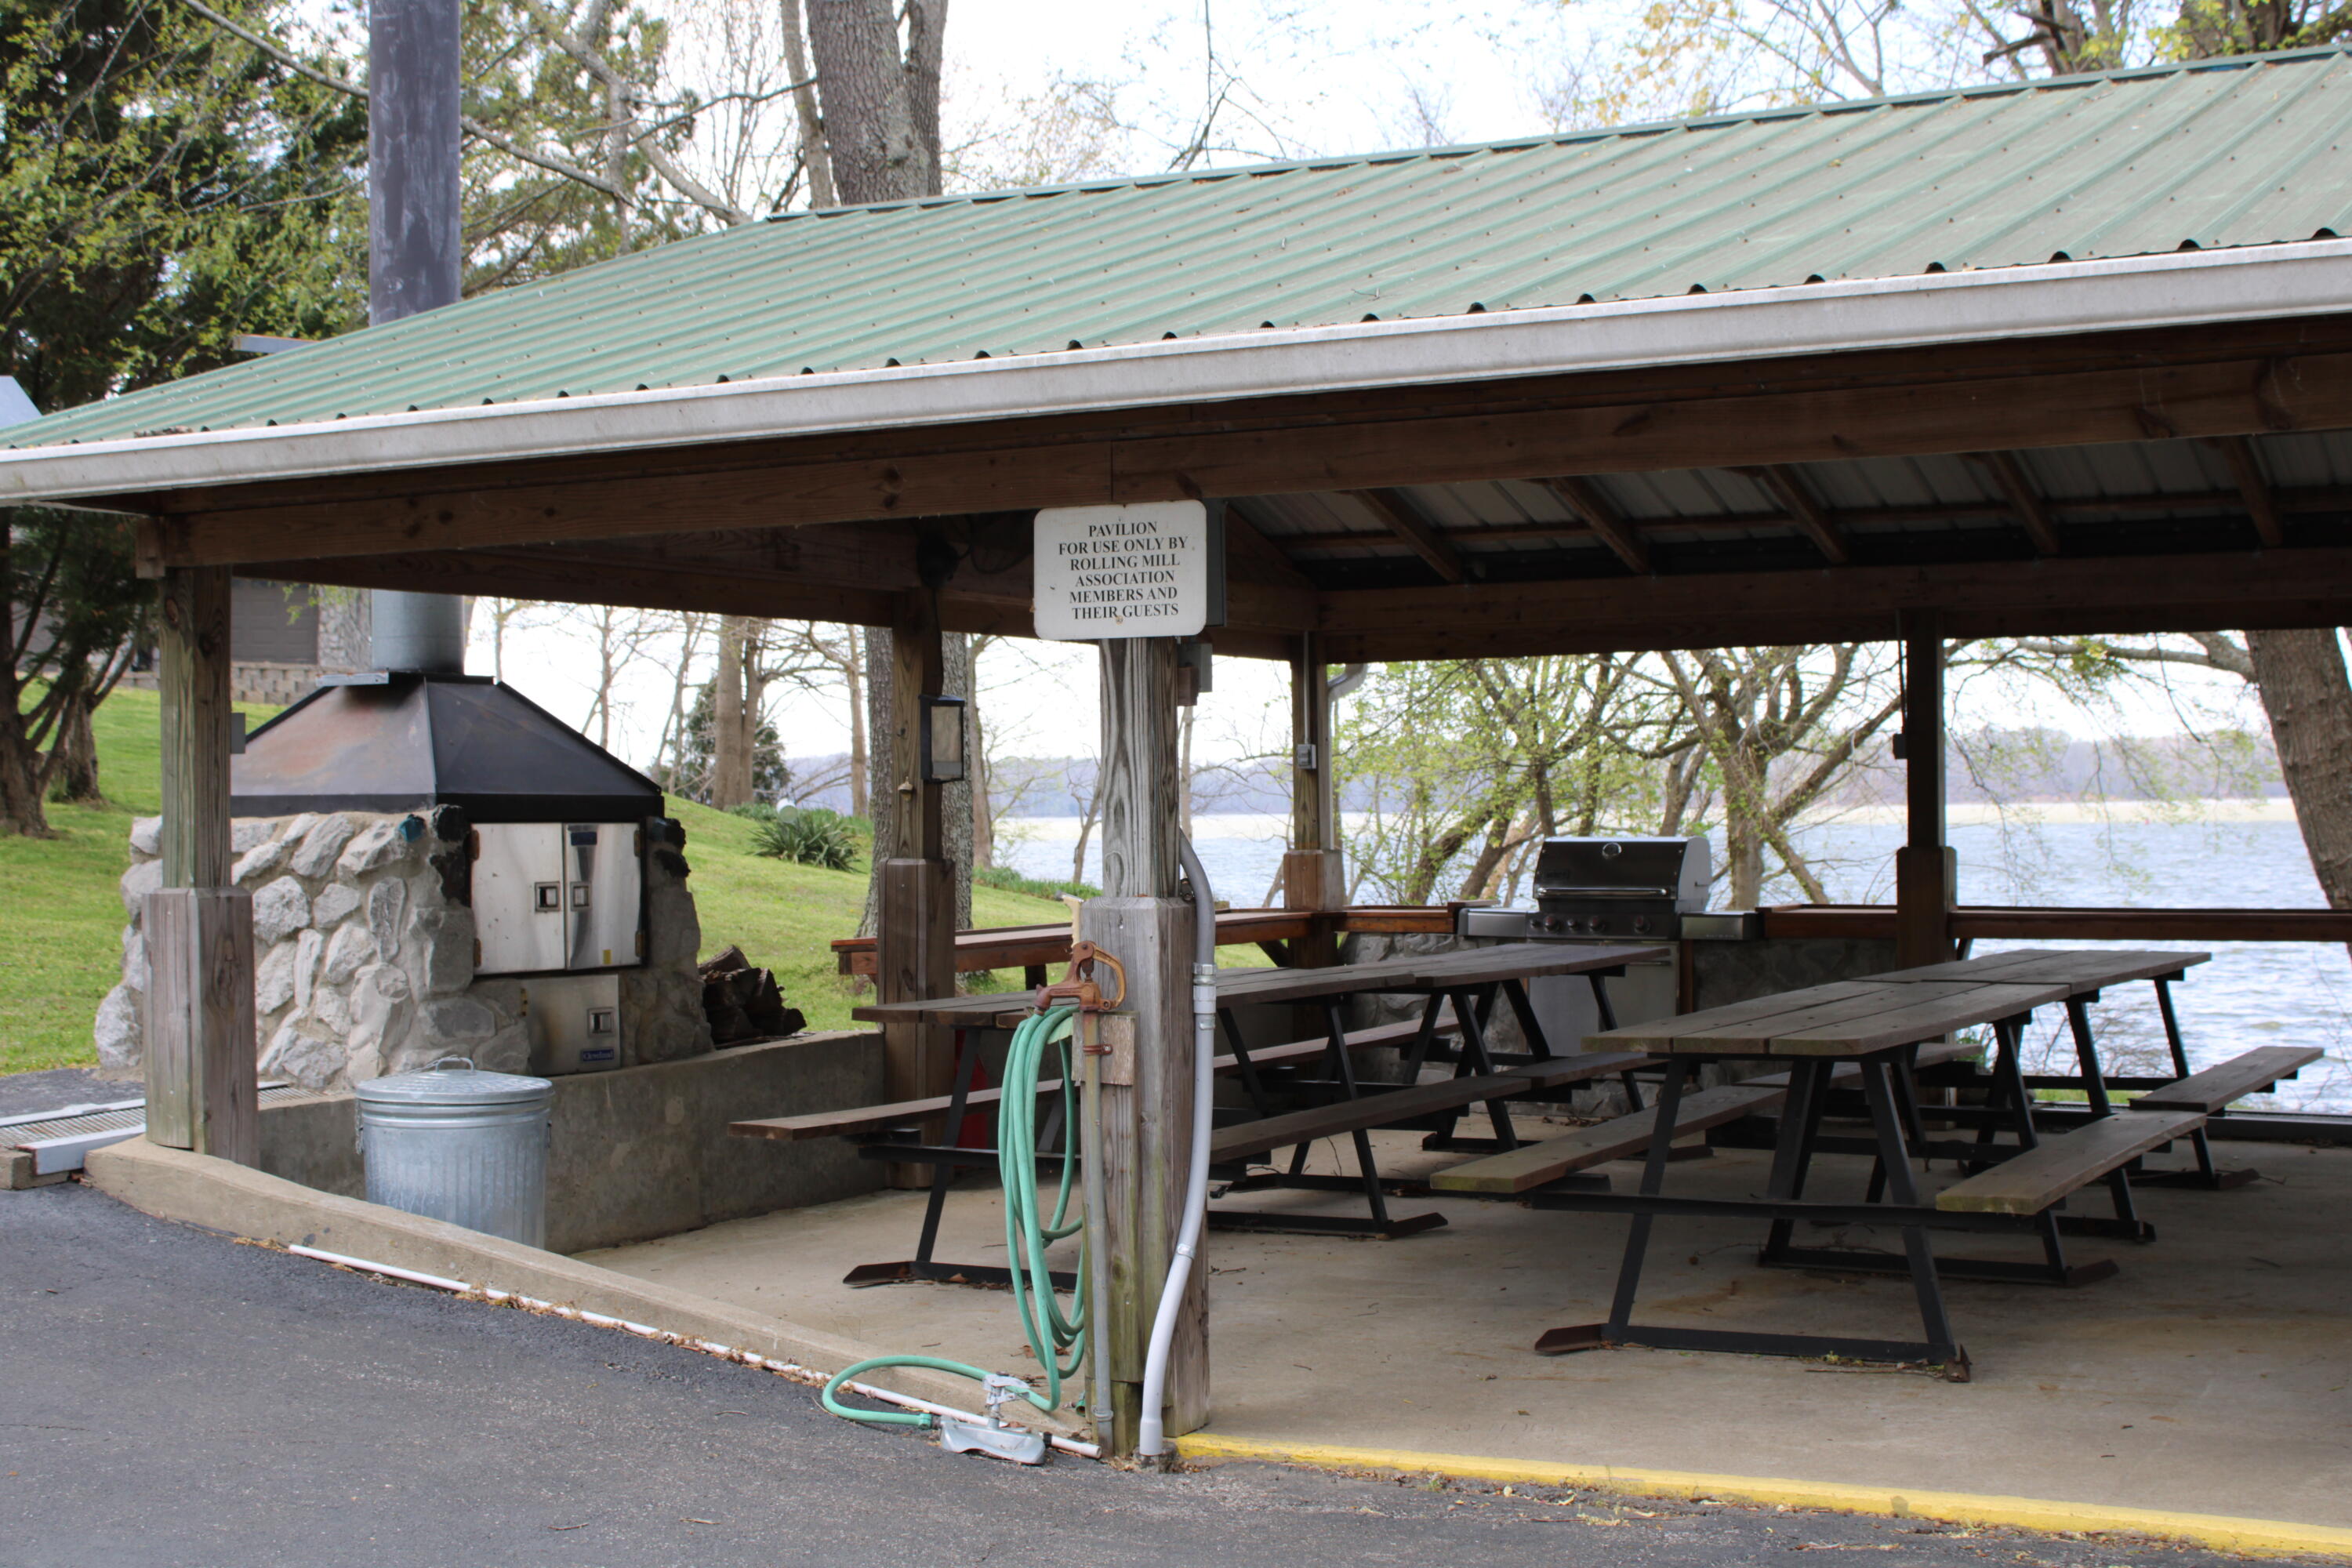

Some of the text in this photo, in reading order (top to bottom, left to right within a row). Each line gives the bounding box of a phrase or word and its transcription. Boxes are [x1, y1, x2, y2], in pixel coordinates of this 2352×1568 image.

[1088, 521, 1158, 537] PAVILION
[1058, 535, 1189, 555] FOR USE ONLY BY
[1070, 554, 1181, 571] ROLLING MILL
[1075, 570, 1174, 587] ASSOCIATION
[1069, 586, 1178, 604] MEMBERS AND
[1072, 603, 1179, 619] THEIR GUESTS
